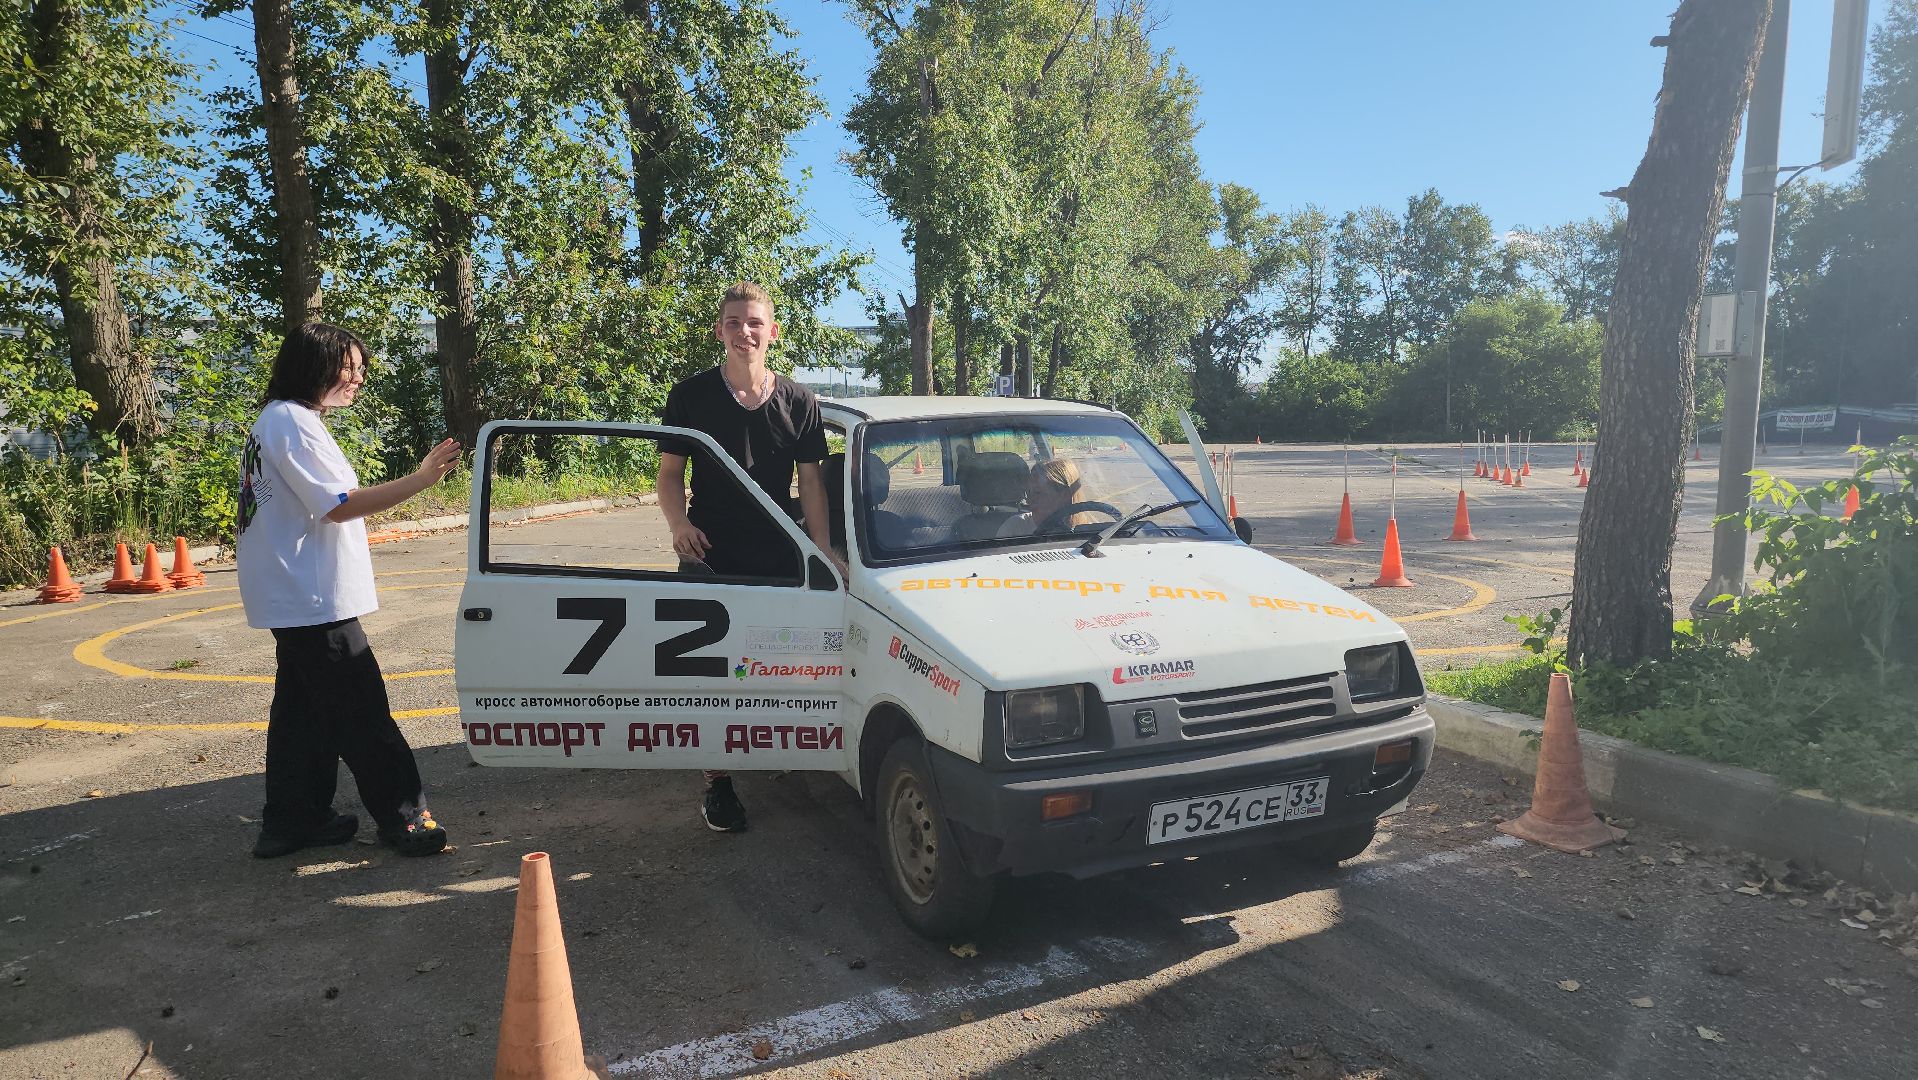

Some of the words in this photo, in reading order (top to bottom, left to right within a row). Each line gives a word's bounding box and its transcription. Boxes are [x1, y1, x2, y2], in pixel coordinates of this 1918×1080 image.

[1000, 376, 1011, 395] P
[900, 578, 1126, 596] автоспорт
[1149, 585, 1228, 602] для
[556, 598, 730, 677] 72
[750, 661, 843, 680] Галамарт
[899, 643, 961, 696] CupperSport
[1128, 660, 1194, 677] KRAMAR
[1150, 671, 1195, 681] MOTORSPORT
[475, 697, 516, 710] кросс
[521, 695, 640, 710] автомногоборье
[644, 697, 730, 708] автослалом
[735, 697, 838, 712] ралли-спринт
[628, 723, 700, 753] для
[725, 723, 844, 753] детей
[1290, 782, 1320, 807] 33
[1286, 806, 1308, 817] RUS
